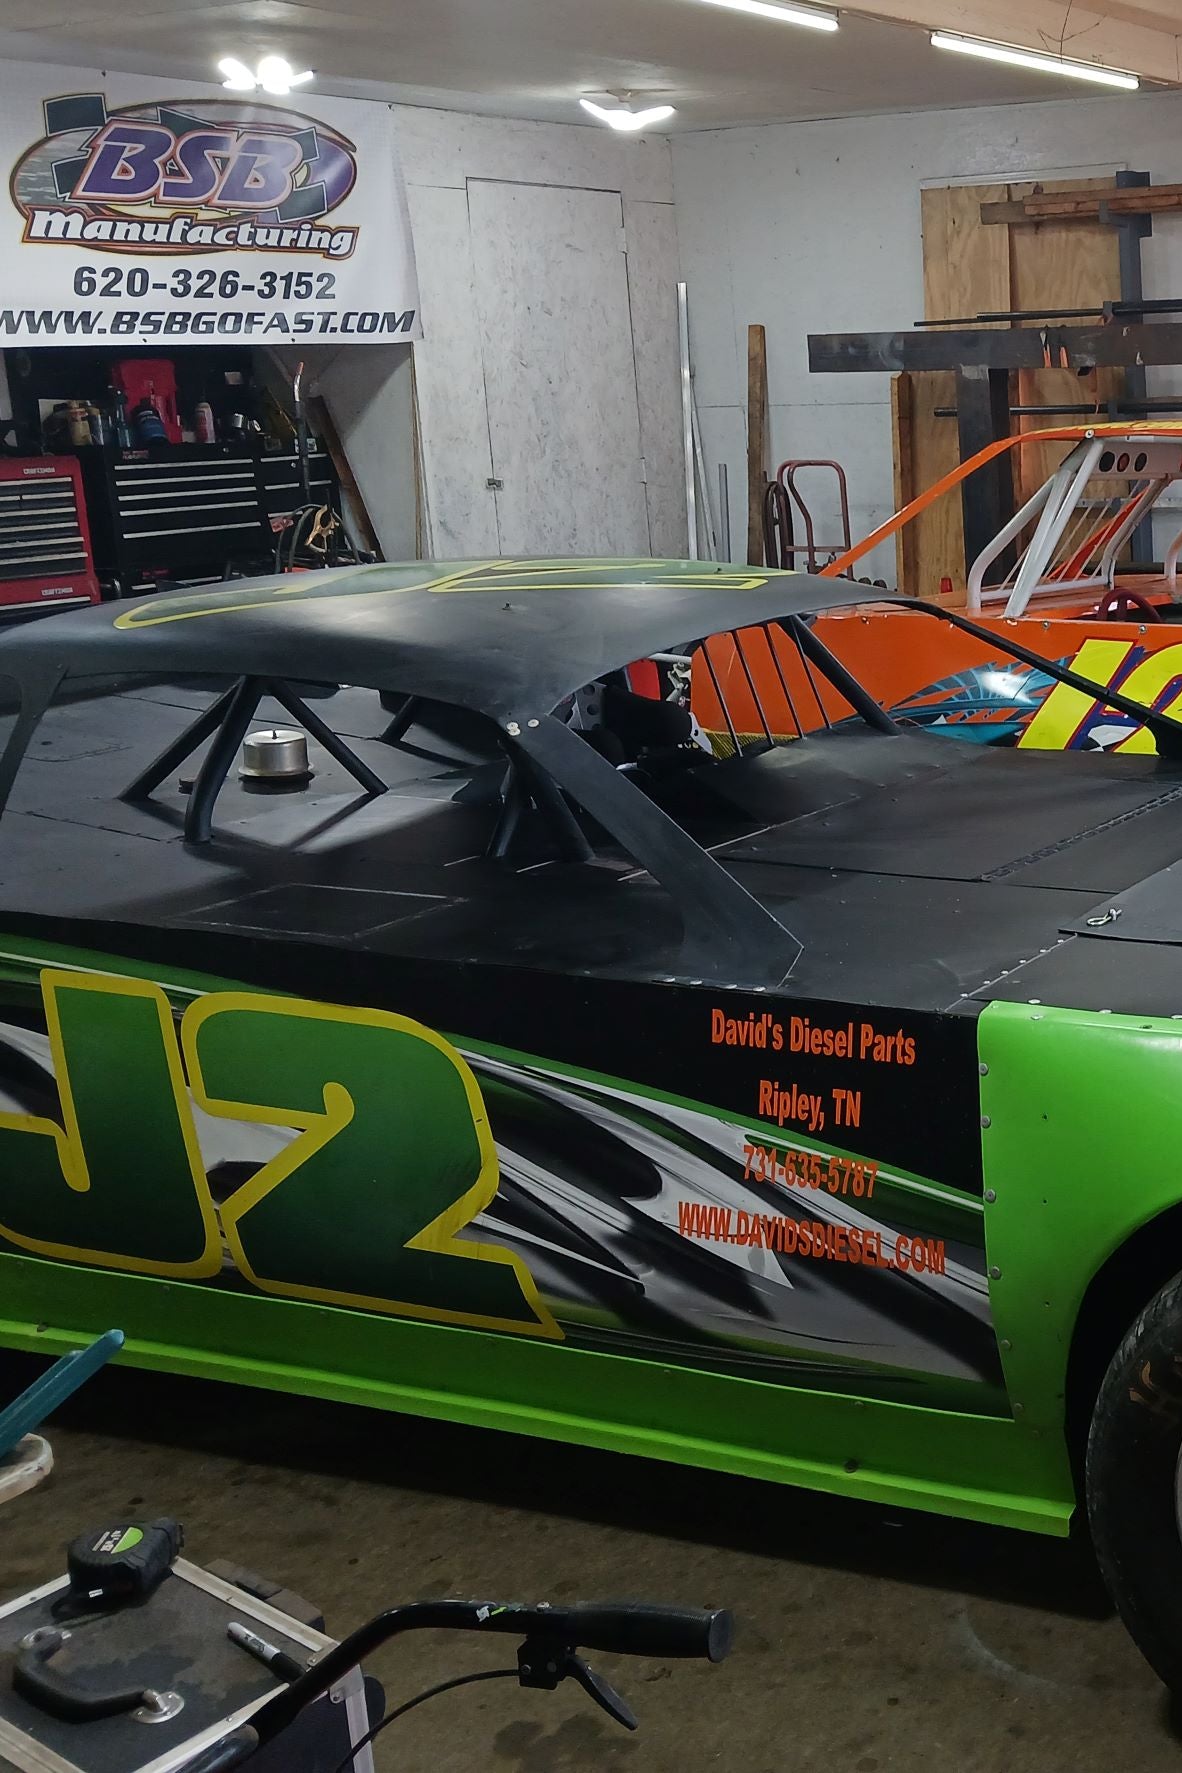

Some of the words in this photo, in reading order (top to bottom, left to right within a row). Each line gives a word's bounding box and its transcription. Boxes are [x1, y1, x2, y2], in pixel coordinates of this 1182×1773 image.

[70, 120, 303, 210] BSB
[29, 210, 355, 255] Manufacturing
[73, 266, 336, 300] 620-326-3152
[711, 1008, 783, 1050] David's
[790, 1016, 854, 1059] Diesel
[860, 1023, 915, 1065] Parts
[759, 1079, 825, 1131] Ripley,
[832, 1088, 862, 1127] TN
[0, 968, 566, 1341] J2
[743, 1144, 879, 1198] 731-635-5787
[678, 1201, 946, 1275] WWW.DAVIDSDIESEL.COM
